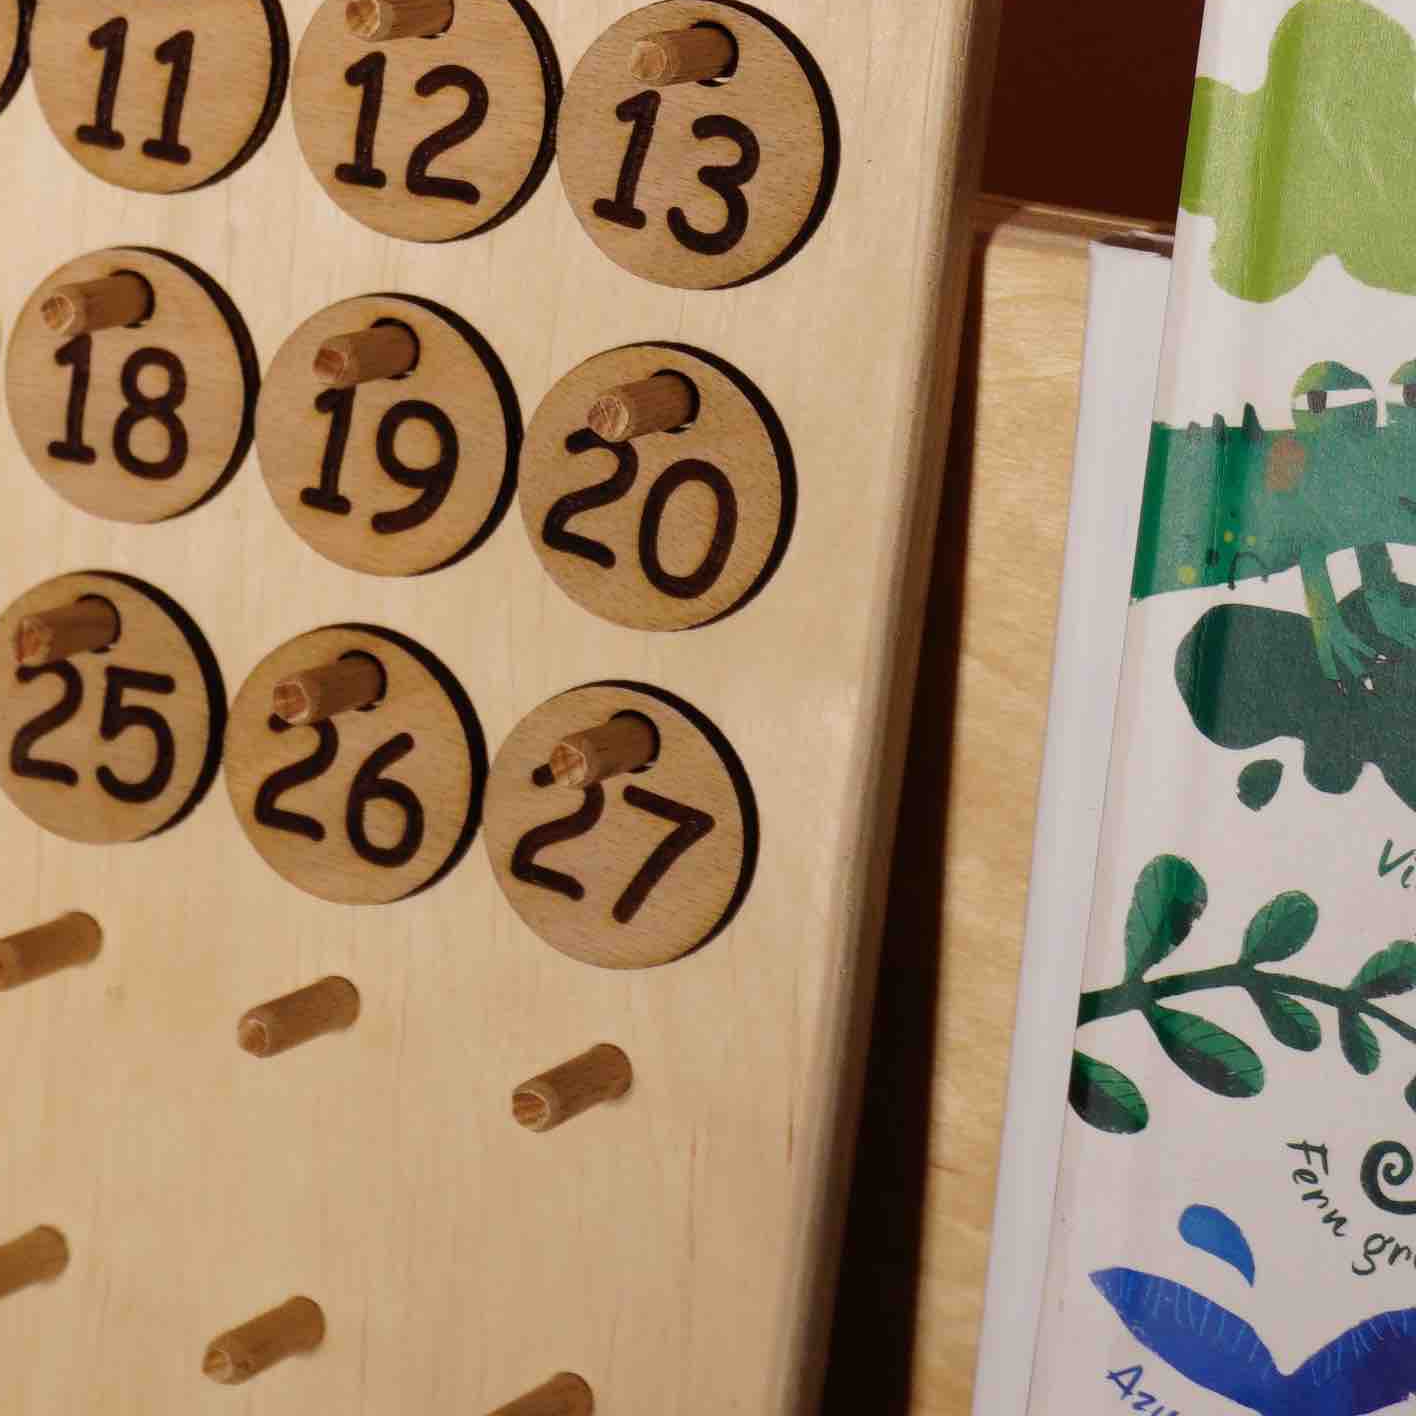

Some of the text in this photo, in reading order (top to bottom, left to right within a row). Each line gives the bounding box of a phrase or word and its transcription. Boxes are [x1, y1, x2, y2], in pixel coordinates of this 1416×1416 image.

[75, 17, 195, 165] 11
[335, 52, 490, 205] 12
[593, 90, 760, 255] 13
[47, 334, 189, 480] 18
[301, 385, 460, 534] 19
[542, 428, 738, 600] 20
[10, 660, 176, 803] 25
[254, 714, 425, 868] 26
[510, 763, 716, 924] 27
[1286, 1140, 1416, 1276] Fern gr
